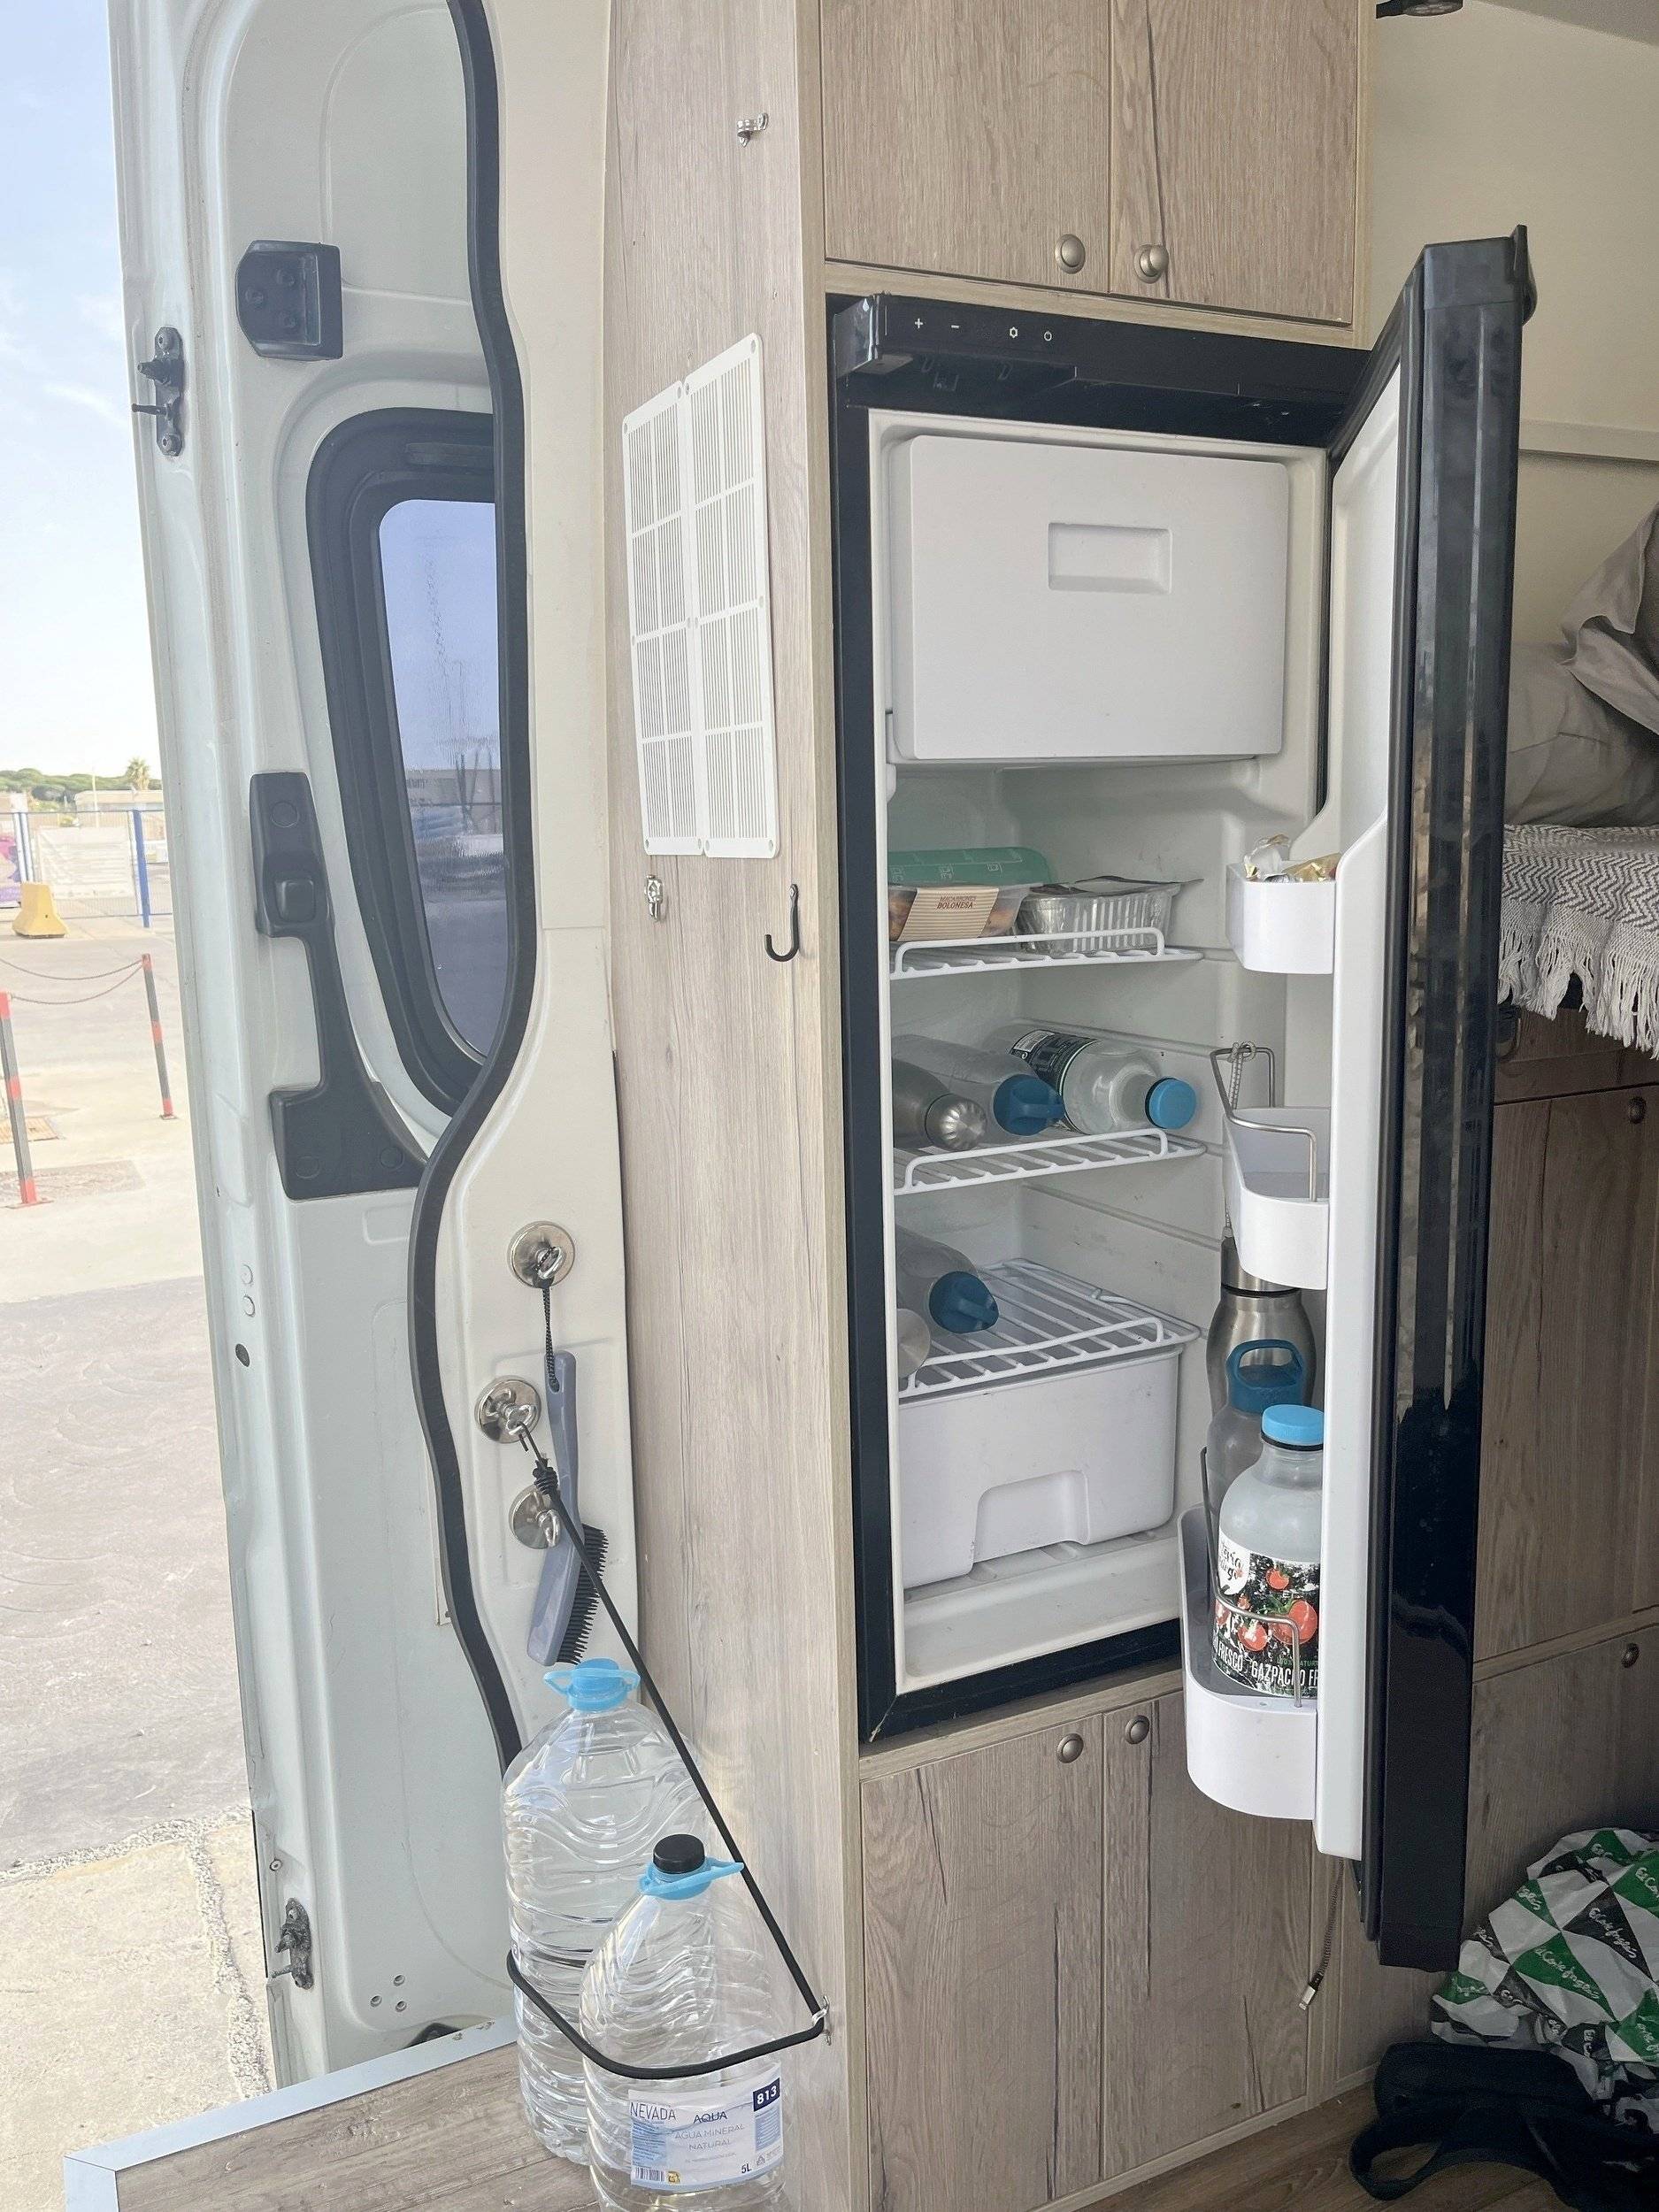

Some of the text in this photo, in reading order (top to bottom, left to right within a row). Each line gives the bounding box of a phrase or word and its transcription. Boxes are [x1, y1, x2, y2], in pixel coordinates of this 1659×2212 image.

[1218, 1640, 1244, 1672] FRESCO
[757, 2085, 777, 2105] 813
[630, 2101, 727, 2124] NEVADA AQUA
[674, 2124, 745, 2139] AGUA MINERAL
[688, 2138, 732, 2151] NATURAL
[741, 2162, 752, 2174] 5L
